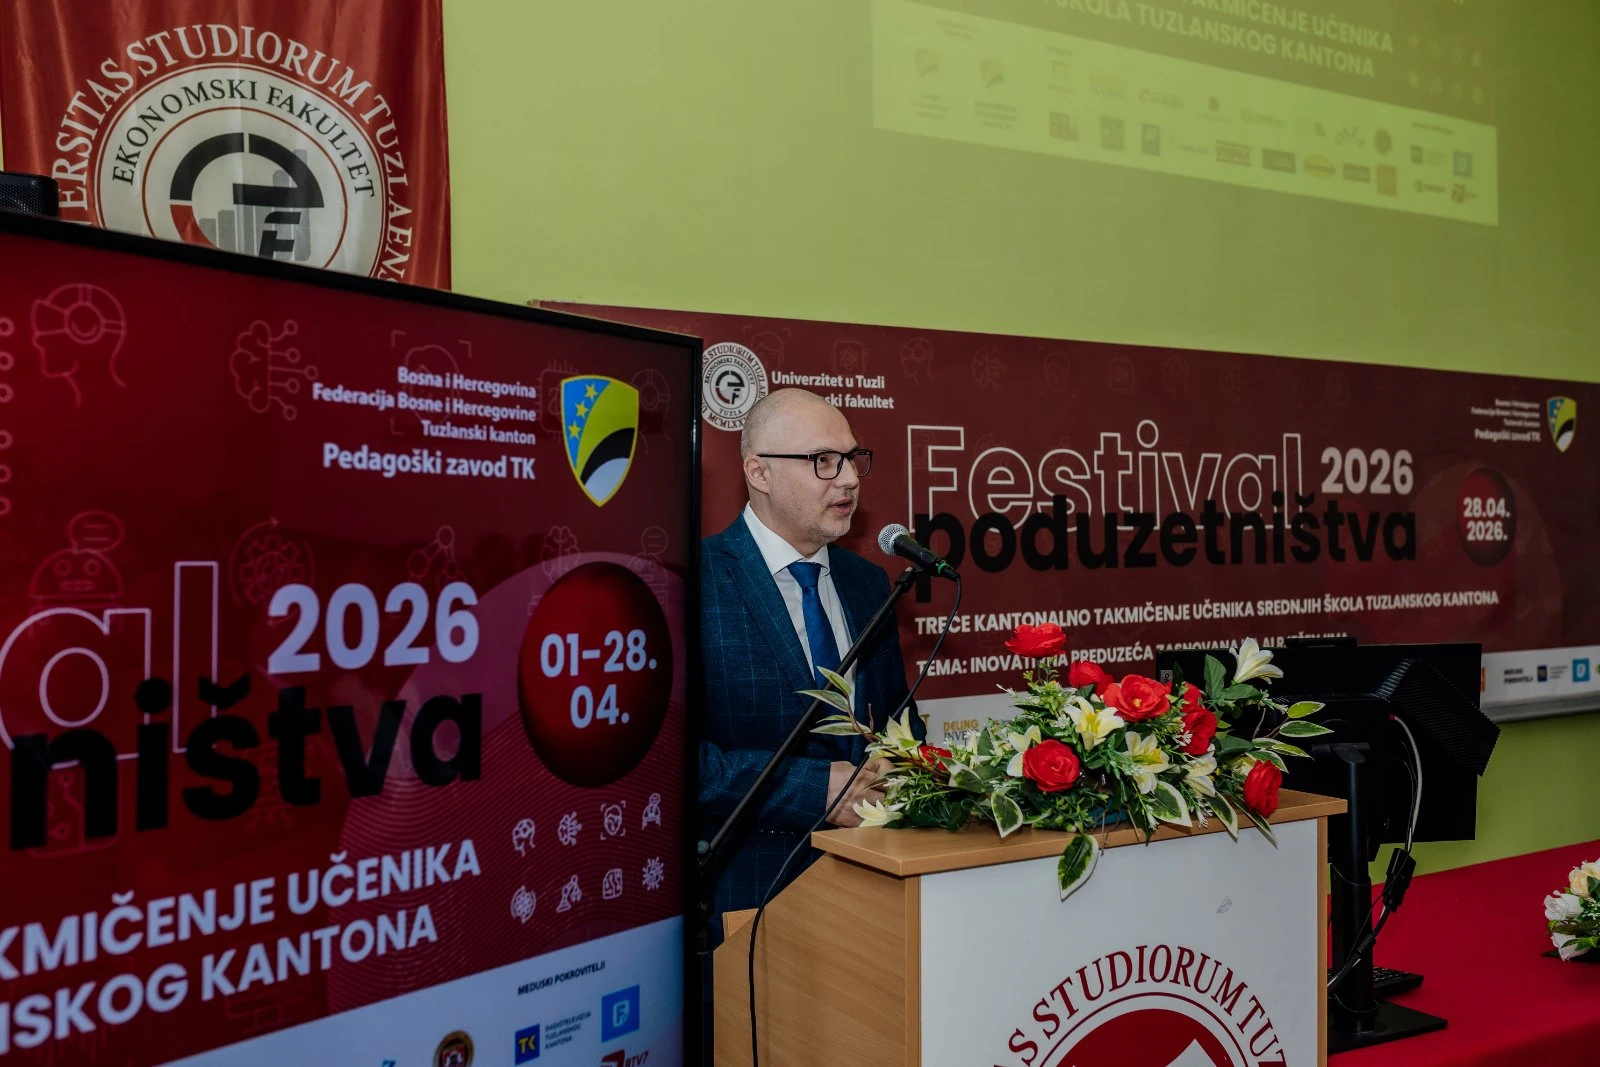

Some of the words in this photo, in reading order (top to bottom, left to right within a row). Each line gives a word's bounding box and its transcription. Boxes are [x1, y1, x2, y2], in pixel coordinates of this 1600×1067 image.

[1136, 4, 1276, 55] TUZLANSKOG
[1280, 36, 1375, 78] KANTONA
[1312, 13, 1393, 54] UČENIKA
[51, 57, 134, 226] ERSITAS
[126, 24, 373, 108] STUDIORUM
[112, 78, 258, 186] EKONOMSKI
[266, 86, 375, 198] FAKULTET
[398, 367, 443, 388] Bosna
[445, 373, 451, 389] i
[453, 374, 536, 399] Hercegovina
[771, 371, 843, 388] Univerzitet
[845, 378, 854, 388] u
[855, 375, 885, 389] Tuzli
[845, 393, 894, 409] fakultet
[312, 382, 394, 411] Federacija
[398, 391, 443, 414] Bosne
[445, 397, 451, 414] i
[453, 398, 536, 422] Hercegovine
[421, 420, 487, 441] Tuzlanski
[490, 426, 536, 445] kanton
[323, 443, 442, 479] Pedagoški
[446, 456, 508, 479] zavod
[510, 457, 536, 479] TK
[907, 420, 1302, 532] Festival
[1319, 446, 1414, 495] 2026
[1463, 497, 1510, 518] 28.04.
[914, 491, 1417, 604] poduzetništva
[1466, 520, 1508, 541] 2026.
[267, 581, 480, 675] 2026
[974, 608, 1090, 632] KANTONALNO
[1094, 601, 1190, 625] TAKMIČENJE
[1193, 598, 1254, 620] UČENIKA
[1257, 596, 1321, 617] SREDNJIH
[1324, 593, 1364, 613] ŠKOLA
[1366, 593, 1441, 611] TUZLANSKOG
[1443, 590, 1499, 606] KANTONA
[916, 657, 967, 677] TEMA:
[570, 685, 630, 729] 04.
[10, 673, 483, 851] ništva
[287, 838, 482, 916] UČENIKA
[201, 905, 438, 1001] KANTONA
[554, 960, 606, 984] POKROVITELJI
[1033, 944, 1248, 1040] STUDIORUM
